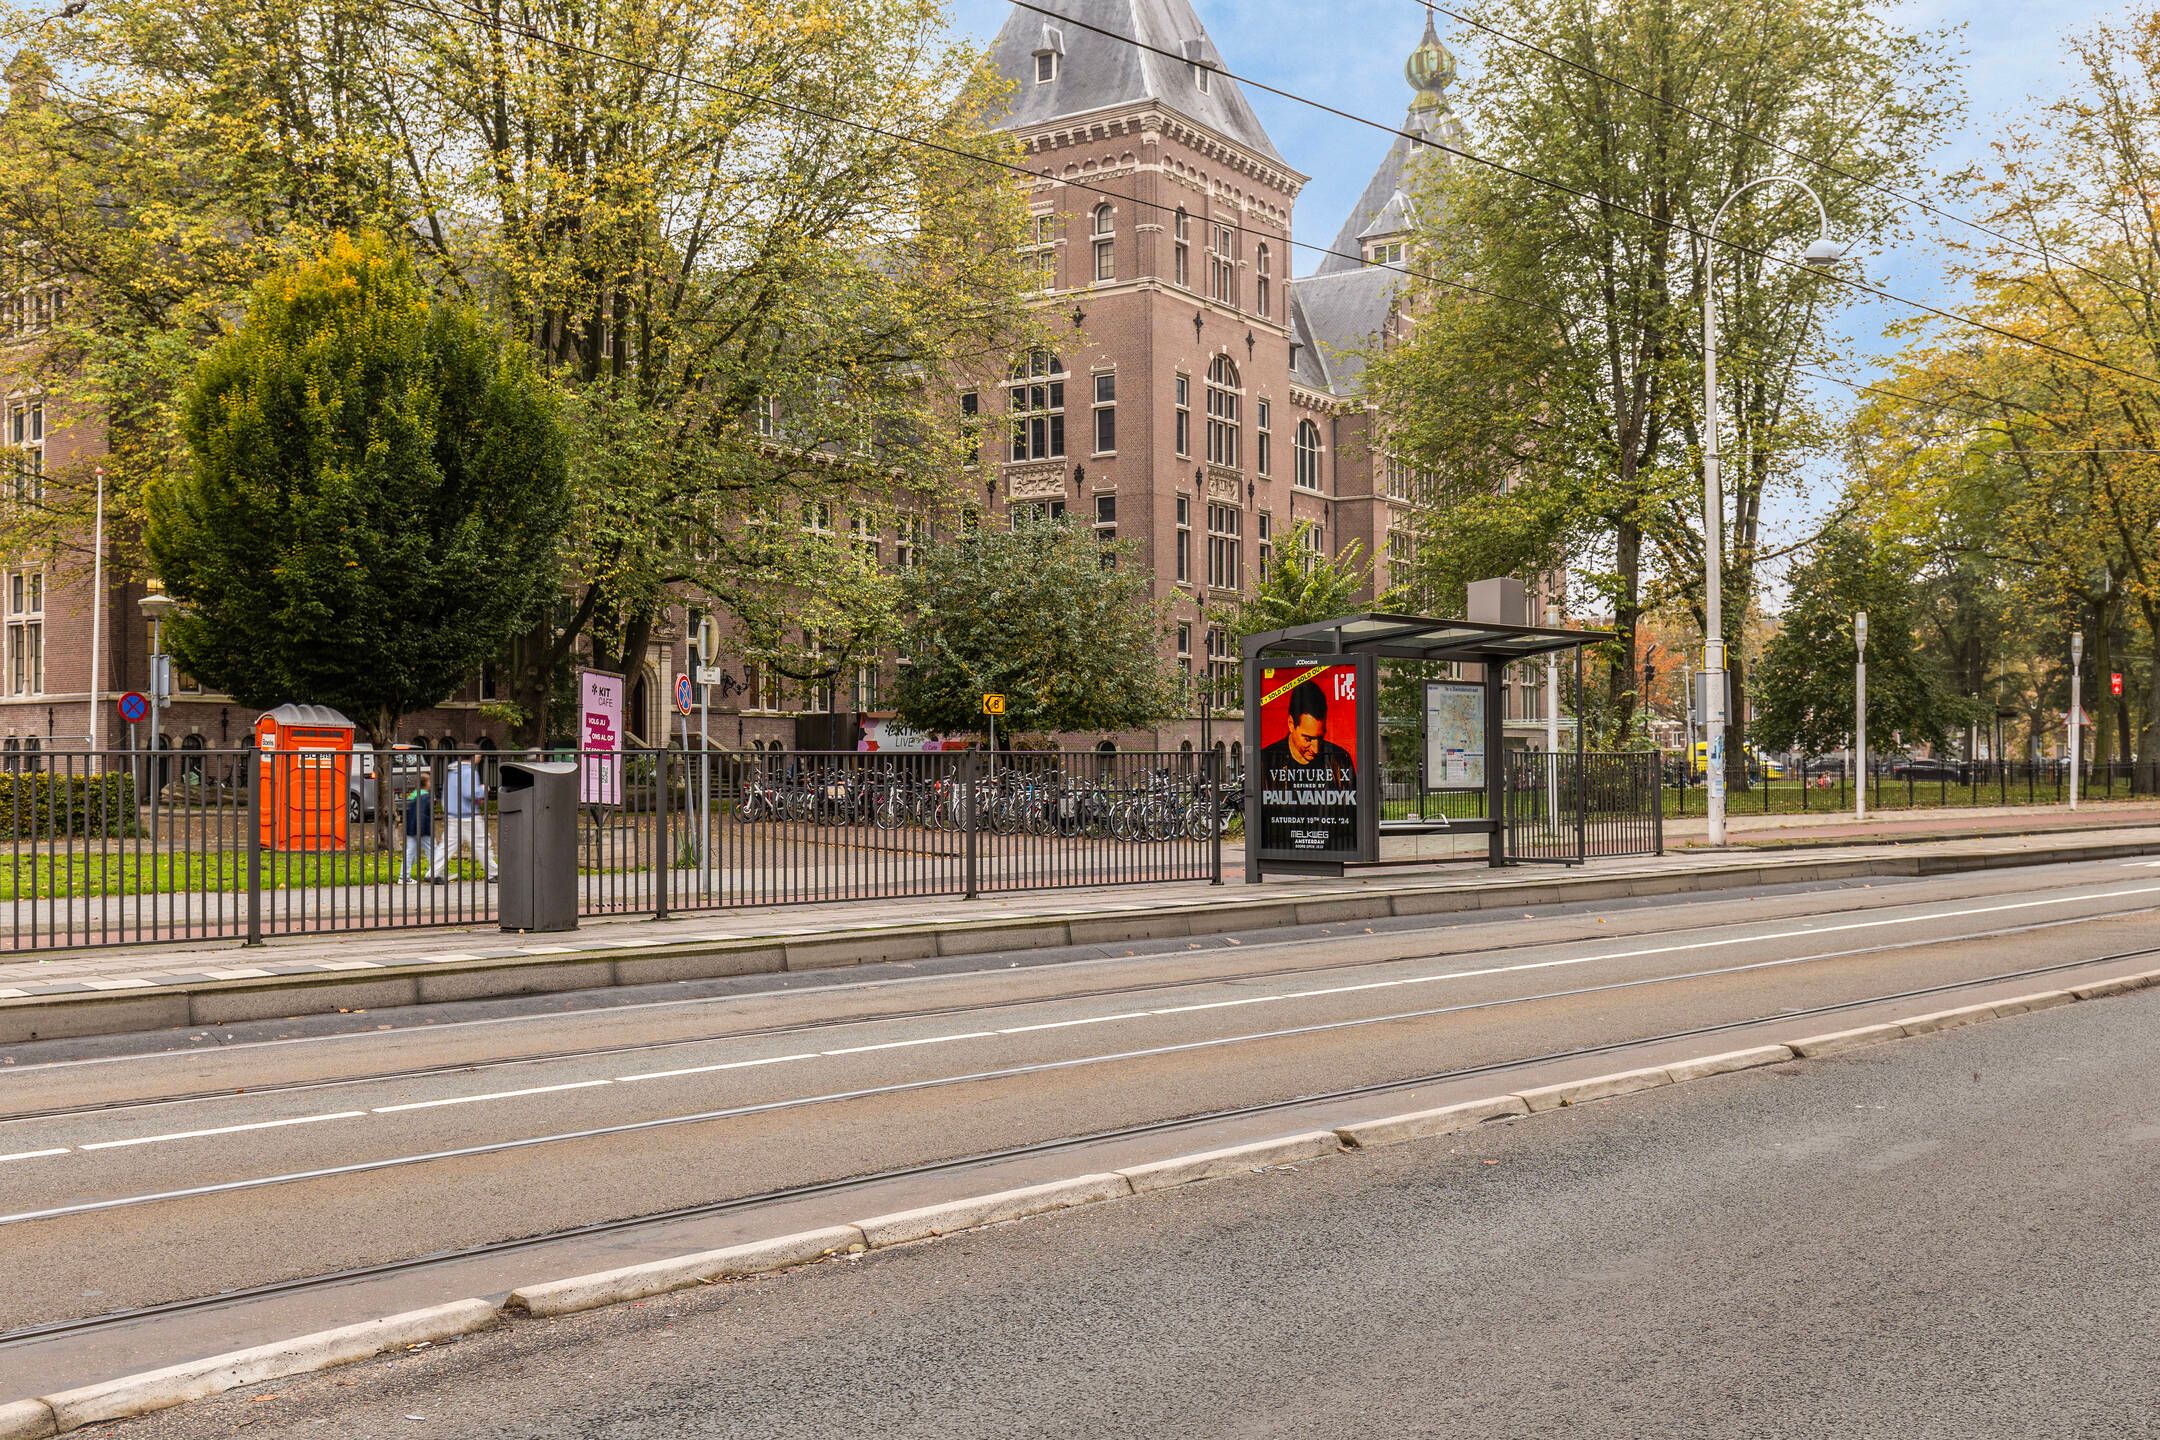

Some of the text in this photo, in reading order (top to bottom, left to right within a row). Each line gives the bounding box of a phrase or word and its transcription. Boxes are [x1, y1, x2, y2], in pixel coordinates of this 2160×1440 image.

[1268, 665, 1323, 700] SOLD OUT SOLD OUT
[599, 686, 611, 697] KIT
[598, 697, 613, 707] CAFE
[895, 737, 914, 747] LIVE
[1269, 768, 1350, 781] VENTURE X
[1263, 790, 1357, 805] PAUL VAN DYK
[1271, 816, 1305, 824] SATURDAY
[1290, 830, 1329, 839] MELKWEG
